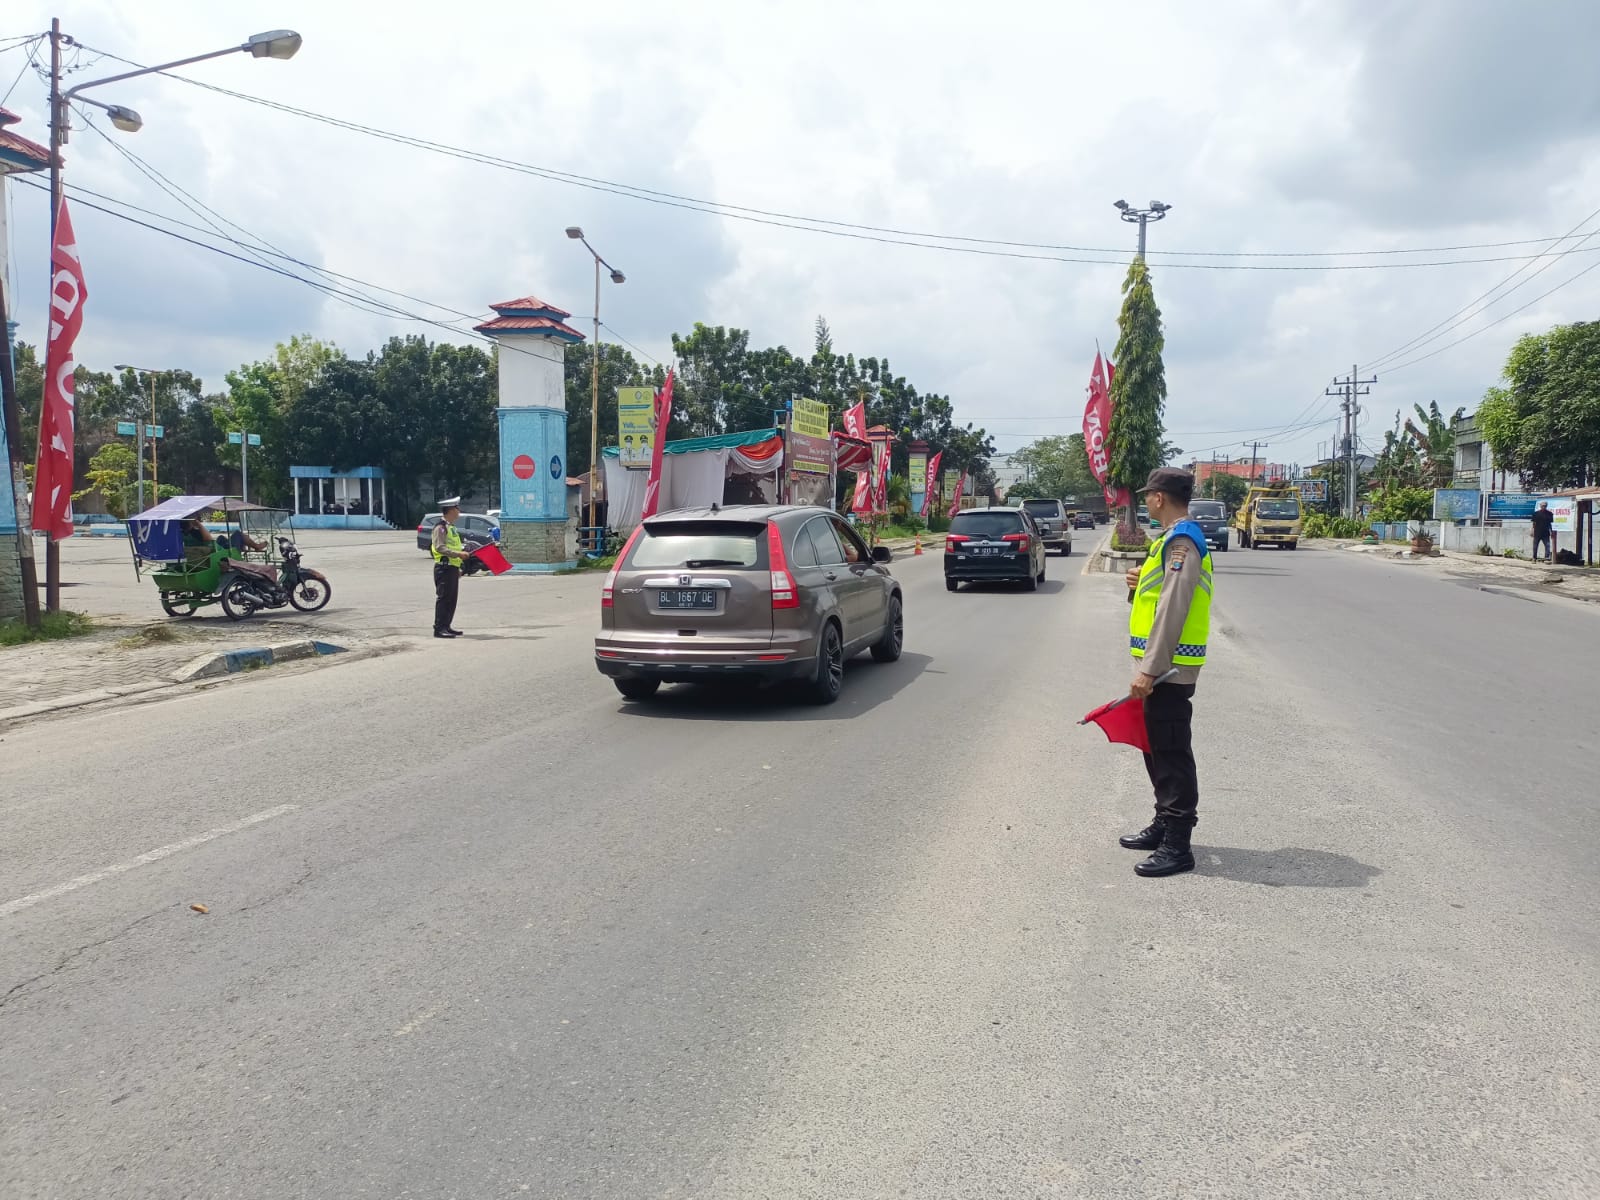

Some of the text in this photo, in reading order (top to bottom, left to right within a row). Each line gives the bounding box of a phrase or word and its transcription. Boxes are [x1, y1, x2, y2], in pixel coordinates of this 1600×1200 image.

[661, 592, 713, 603] BL 1667 DE
